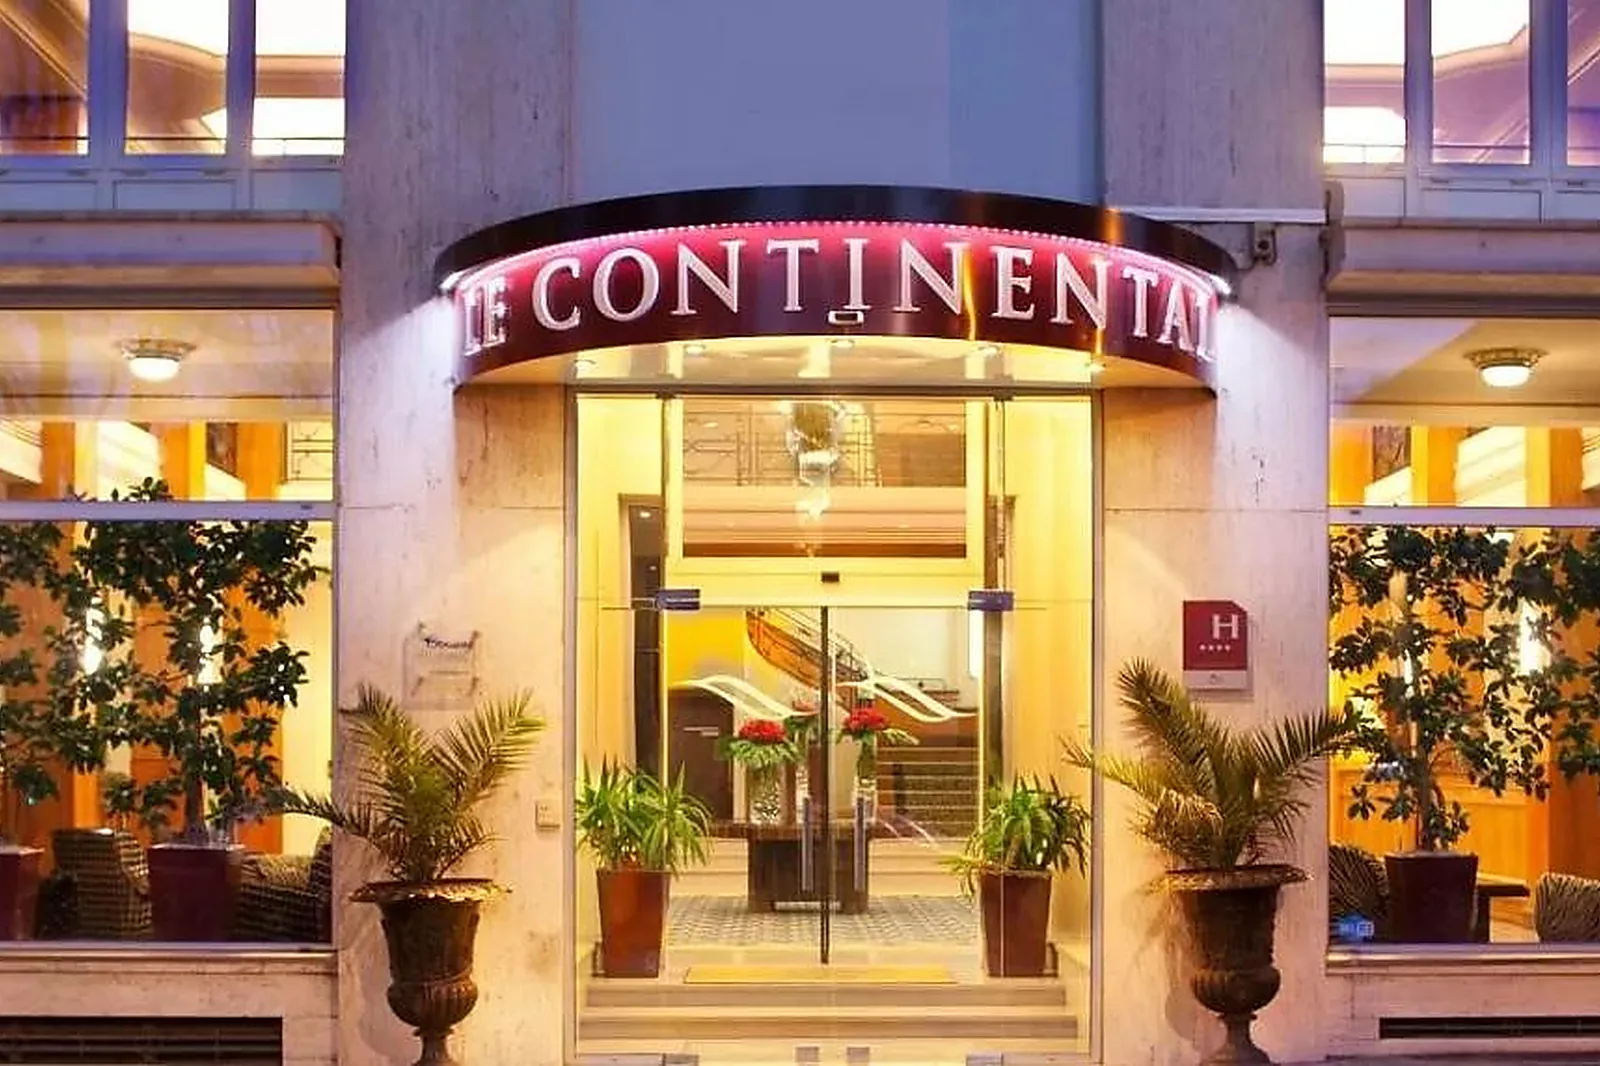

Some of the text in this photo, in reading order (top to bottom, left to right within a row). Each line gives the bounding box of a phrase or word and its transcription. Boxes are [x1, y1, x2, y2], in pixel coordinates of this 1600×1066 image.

[462, 237, 1217, 362] LE CONTINENTAL
[1212, 613, 1239, 640] H
